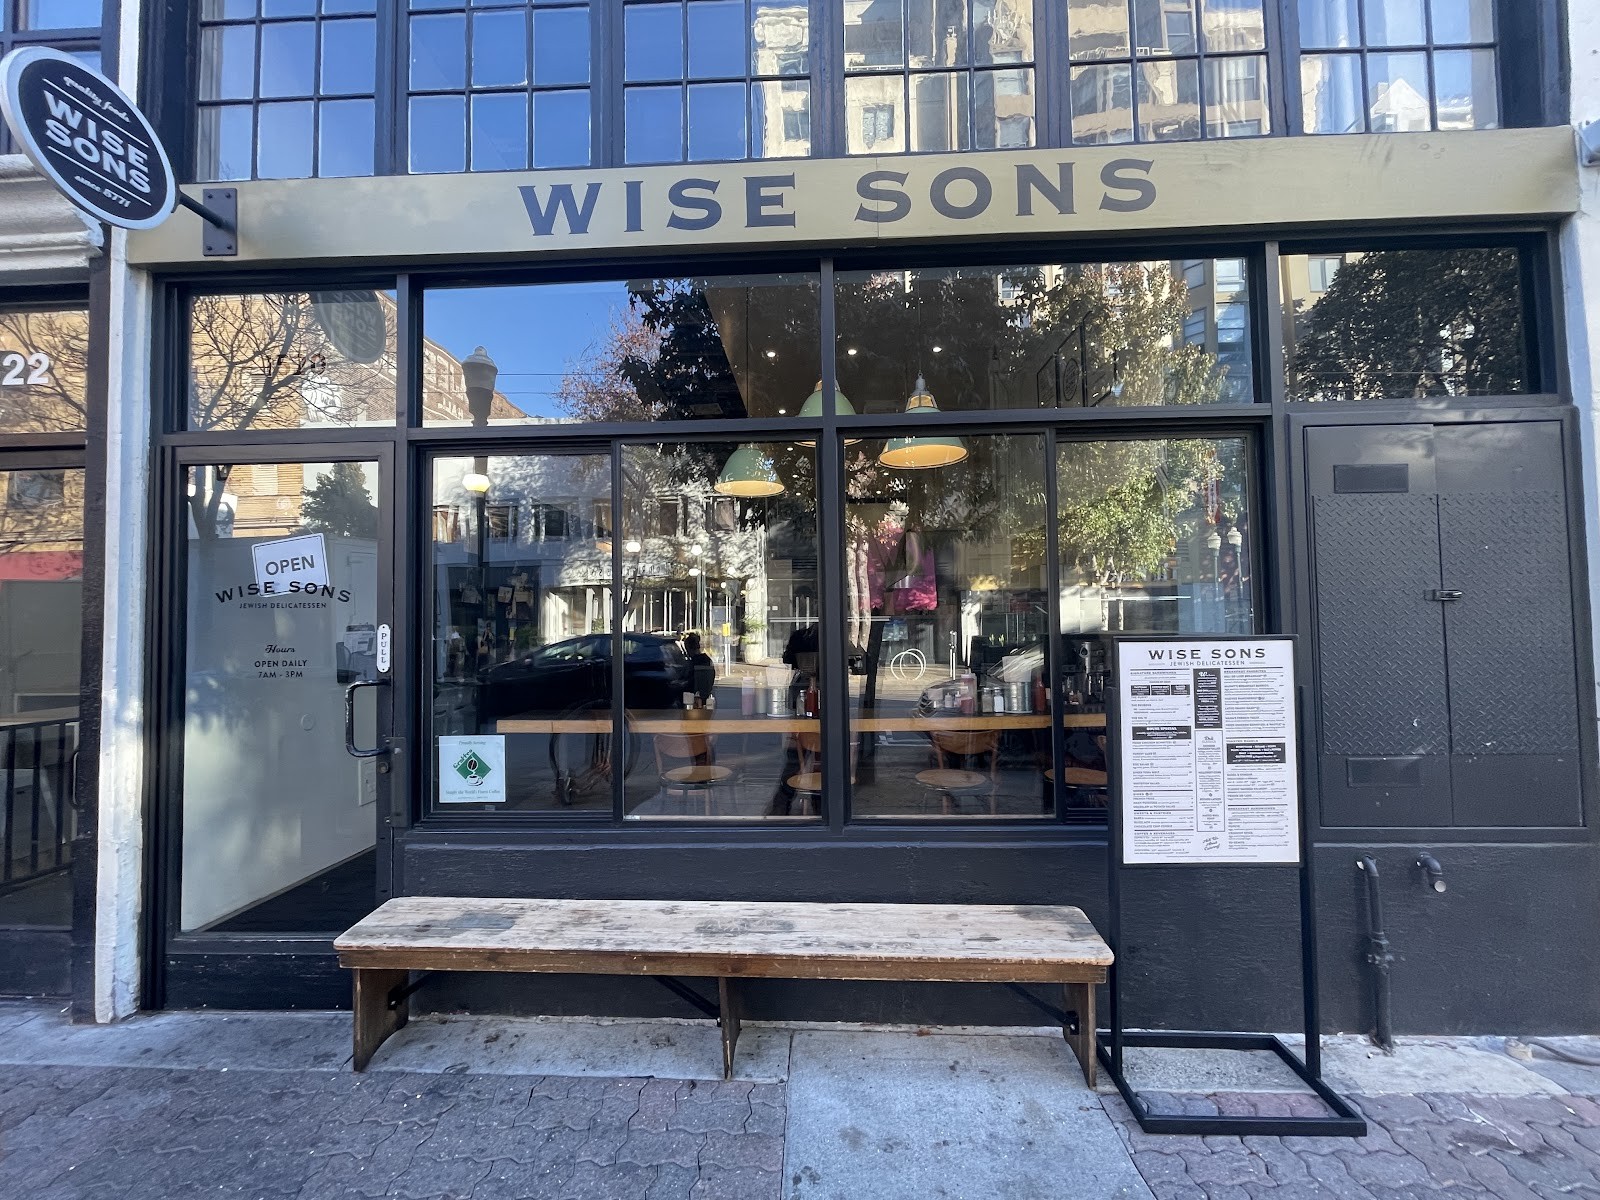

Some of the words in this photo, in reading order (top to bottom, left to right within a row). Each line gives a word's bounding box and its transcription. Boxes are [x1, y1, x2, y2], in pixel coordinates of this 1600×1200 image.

[63, 76, 102, 107] quality
[101, 100, 131, 123] foods
[43, 90, 149, 175] WISE
[45, 119, 151, 194] SONS
[74, 175, 102, 193] since
[103, 189, 131, 208] 5771
[517, 171, 796, 236] WISE
[854, 158, 1156, 224] SONS
[2, 353, 50, 385] 22
[265, 555, 315, 575] OPEN
[216, 581, 275, 603] WISE
[289, 580, 351, 603] SONS
[265, 644, 296, 654] Hours
[1148, 649, 1201, 660] WISE
[1211, 648, 1266, 659] SONS
[254, 660, 279, 668] OPEN
[282, 659, 308, 667] DAILY
[258, 671, 277, 679] 7AM
